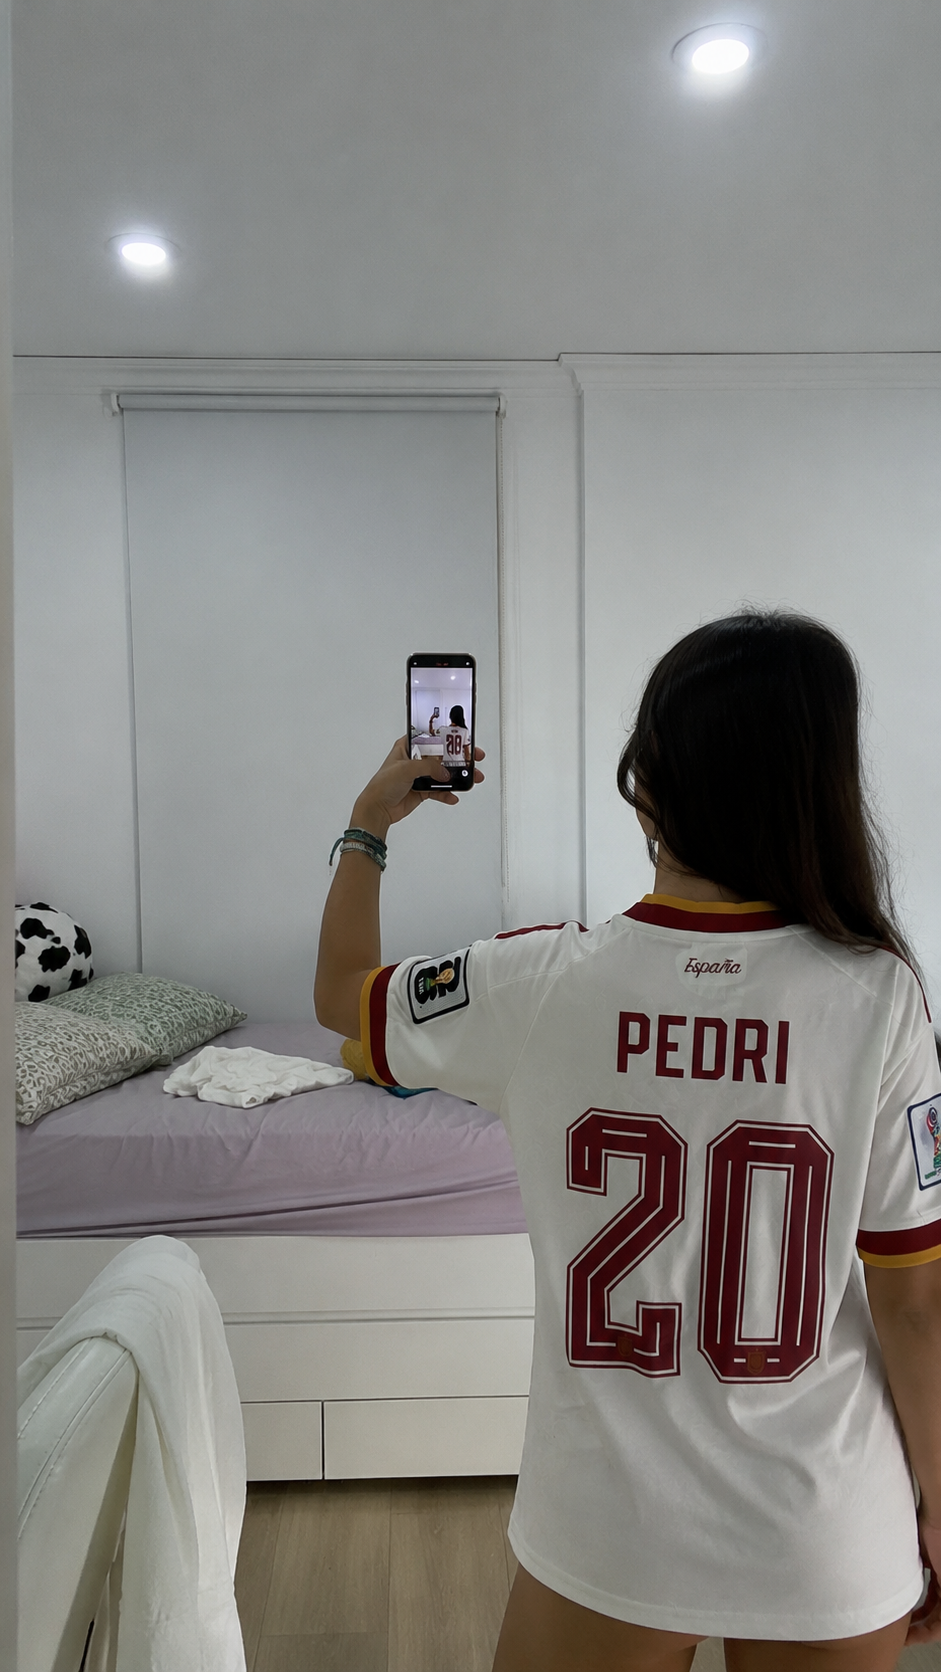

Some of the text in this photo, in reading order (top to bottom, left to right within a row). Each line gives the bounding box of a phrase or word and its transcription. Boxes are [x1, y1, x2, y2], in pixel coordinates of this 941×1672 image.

[684, 958, 742, 978] España
[617, 1011, 789, 1084] PEDRI
[566, 1107, 834, 1384] 20
